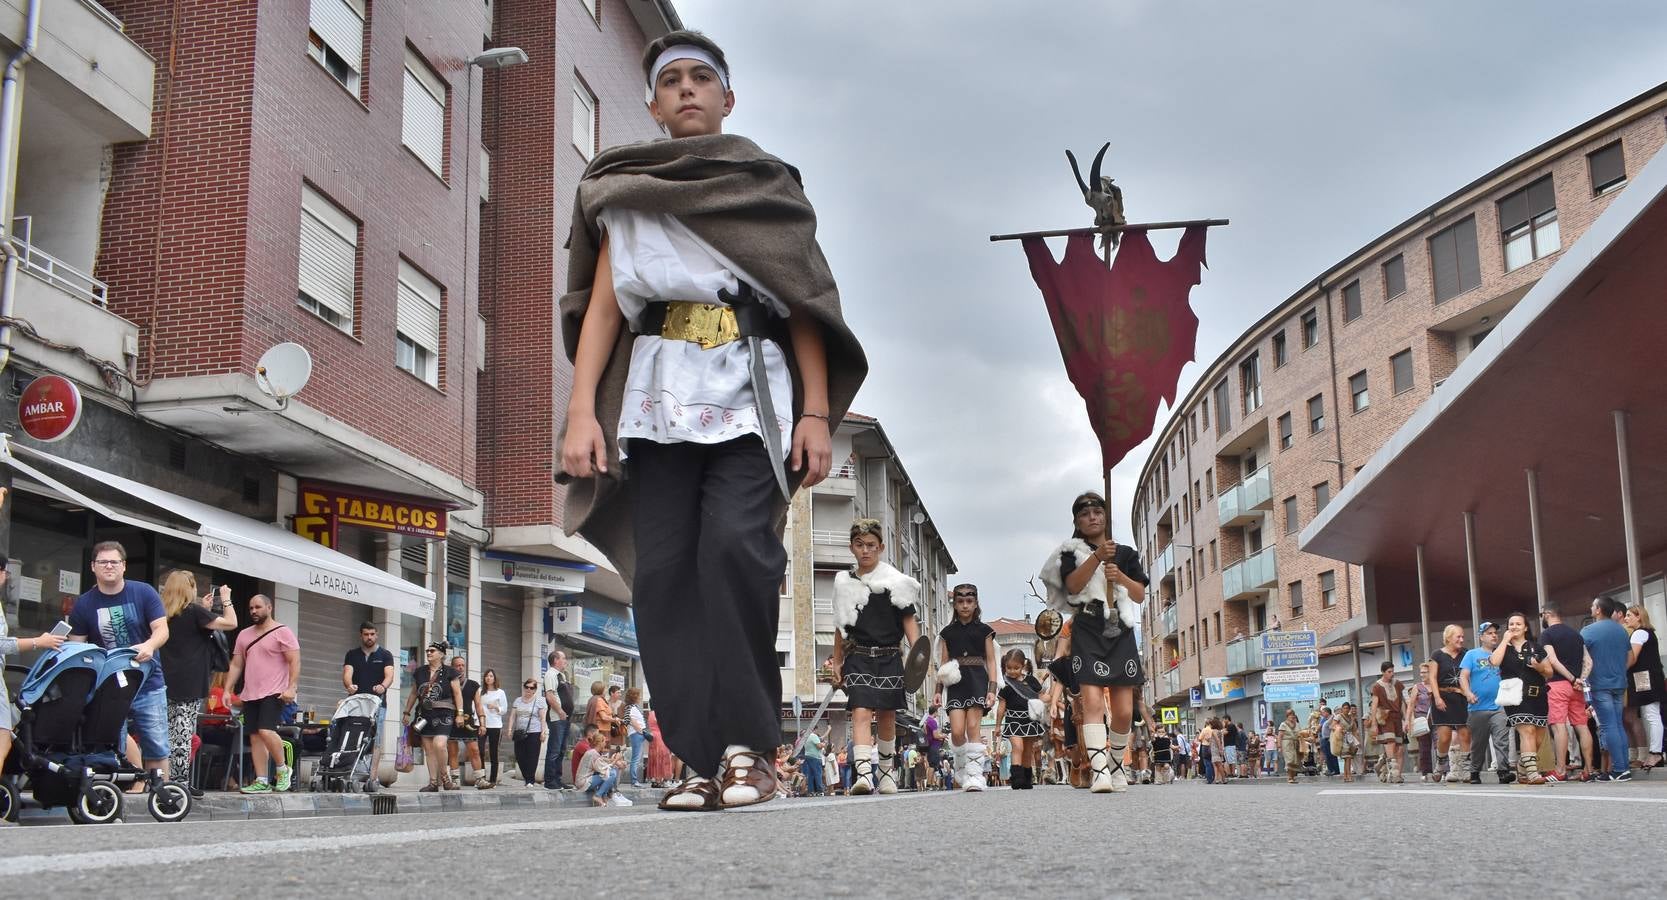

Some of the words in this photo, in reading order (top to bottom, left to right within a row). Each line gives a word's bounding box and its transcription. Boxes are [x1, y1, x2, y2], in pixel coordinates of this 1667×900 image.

[25, 401, 64, 416] AMBAR
[336, 498, 438, 529] TABACOS
[206, 542, 229, 556] AMSTEL
[310, 571, 320, 586] LA
[324, 575, 359, 596] PARADA
[1194, 690, 1200, 700] P
